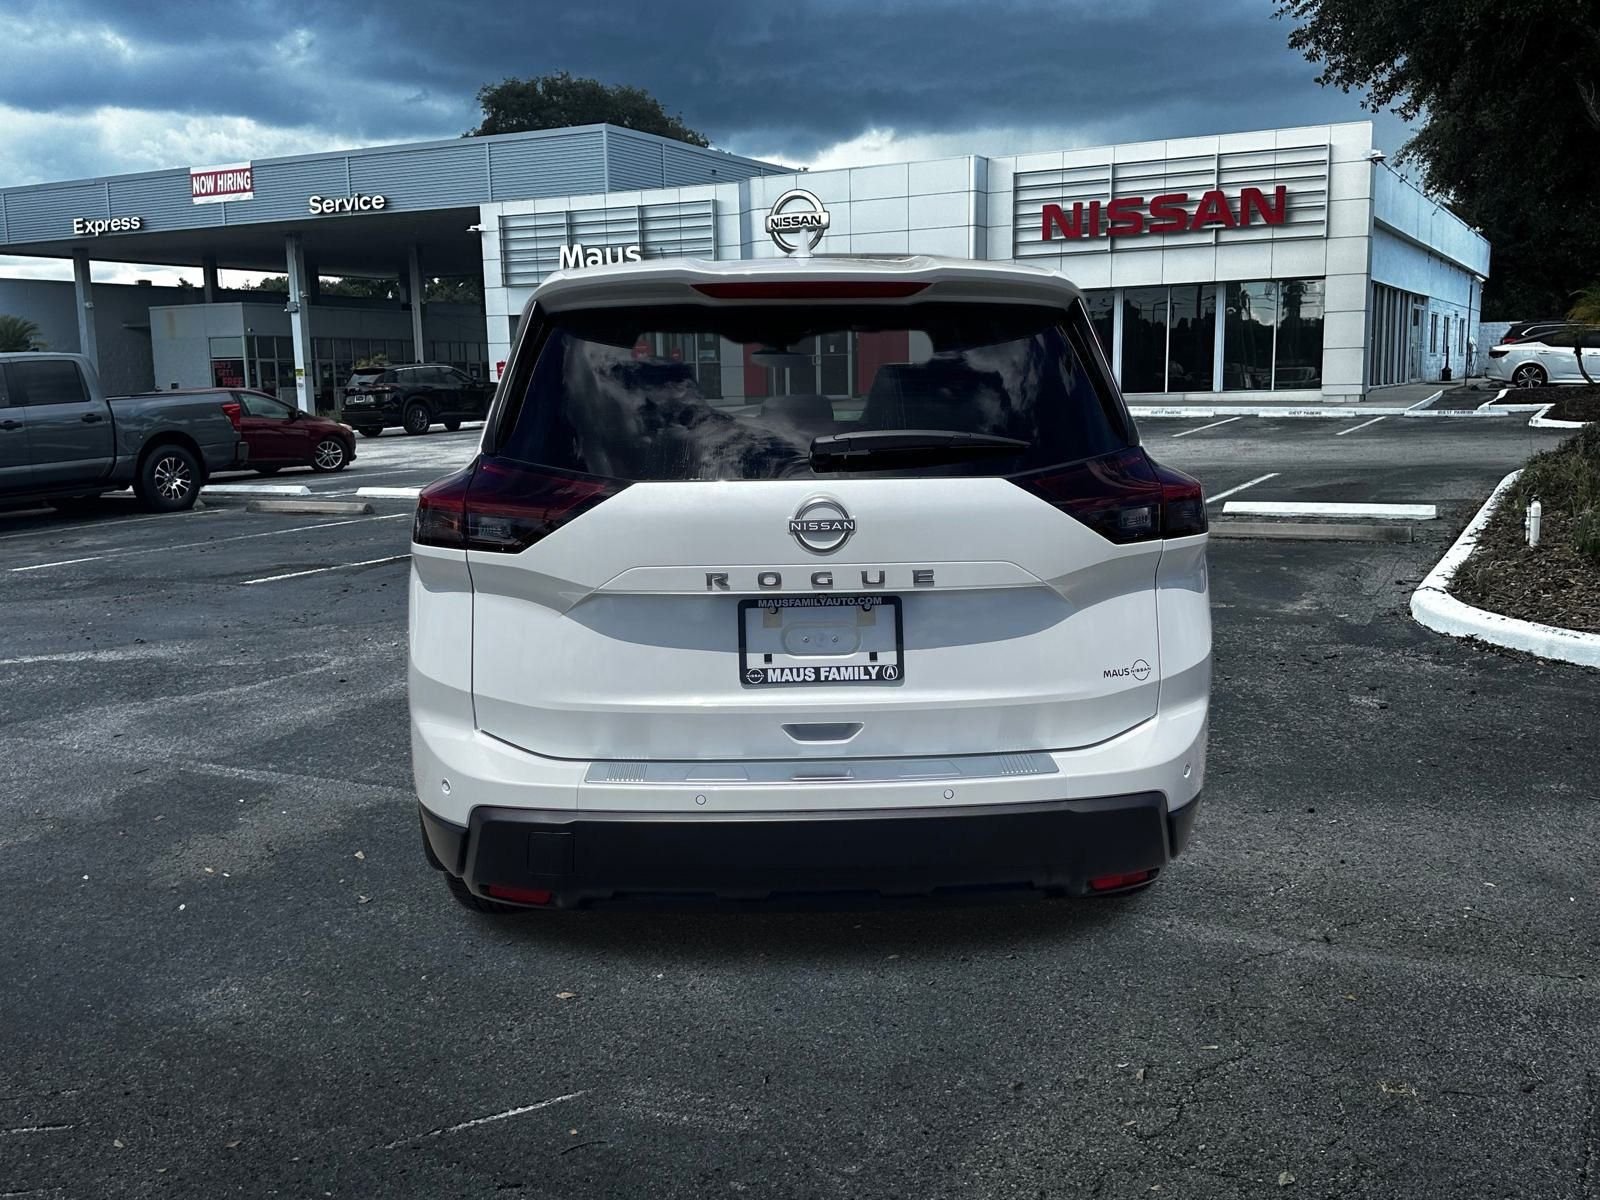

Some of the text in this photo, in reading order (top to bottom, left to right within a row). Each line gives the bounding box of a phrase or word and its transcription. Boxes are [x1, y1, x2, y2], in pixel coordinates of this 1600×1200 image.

[192, 171, 251, 195] NOW HIRING
[309, 193, 385, 215] Service
[1042, 185, 1287, 241] NISSAN
[73, 215, 140, 236] Express
[770, 214, 822, 229] NISSAN
[559, 243, 642, 269] Maus
[791, 521, 854, 531] NISSAN
[705, 569, 935, 588] ROGUE
[757, 596, 883, 608] MAUSFAMILYAUTO.COM
[767, 665, 880, 683] MAUS FAMILY
[1103, 667, 1130, 678] MAUS
